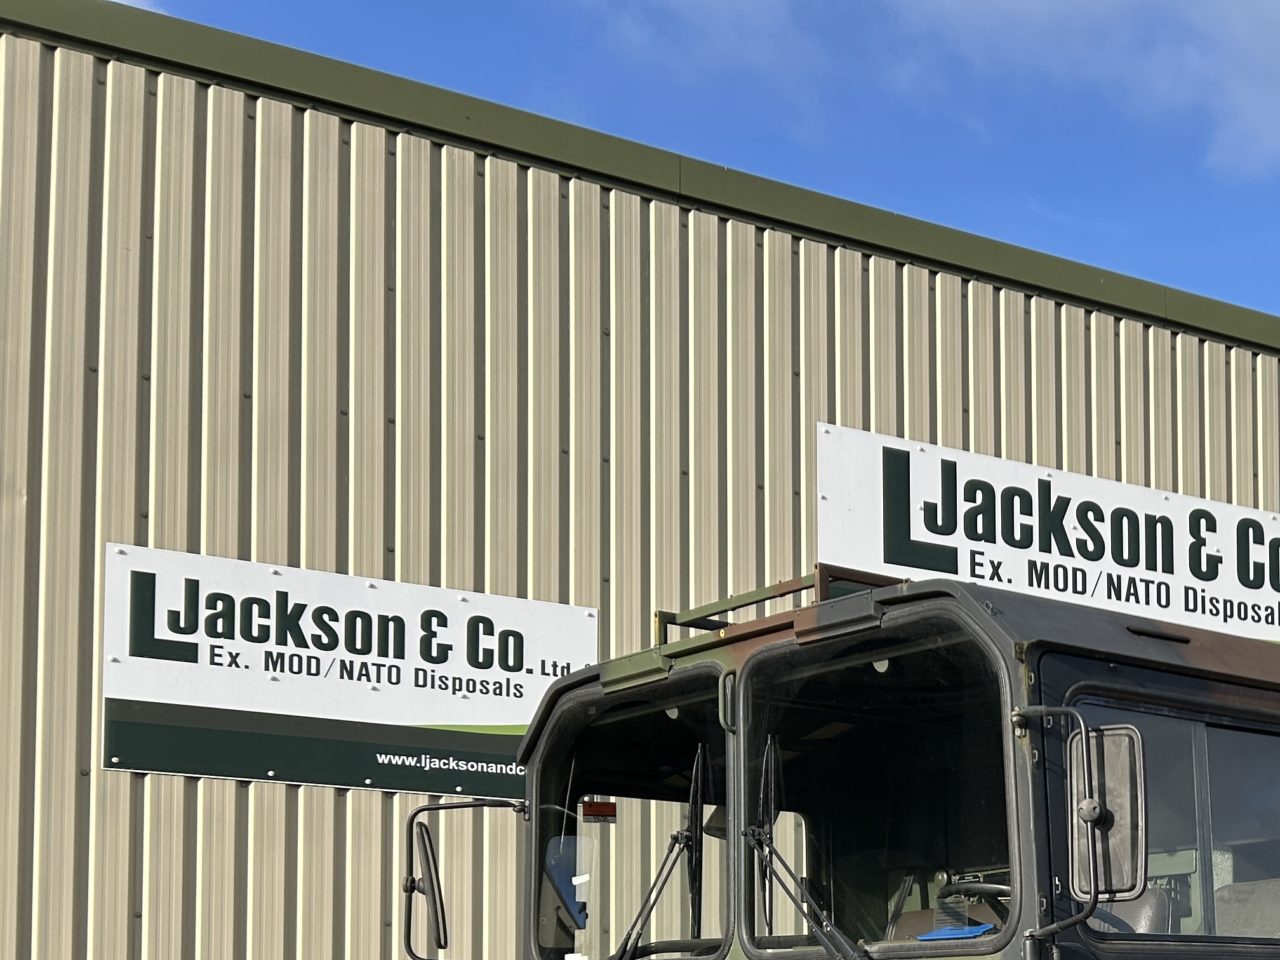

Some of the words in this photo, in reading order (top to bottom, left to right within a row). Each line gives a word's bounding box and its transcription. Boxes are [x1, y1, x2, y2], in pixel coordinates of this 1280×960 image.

[1189, 508, 1223, 582] &
[969, 549, 1013, 584] Ex.
[1027, 559, 1171, 609] MOD/NATO
[209, 644, 250, 670] Ex.
[264, 650, 401, 686] MOD/NATO
[414, 667, 524, 699] Disposals
[420, 609, 453, 665] &
[466, 615, 534, 675] Co.
[376, 753, 528, 776] www.ljacksonandc
